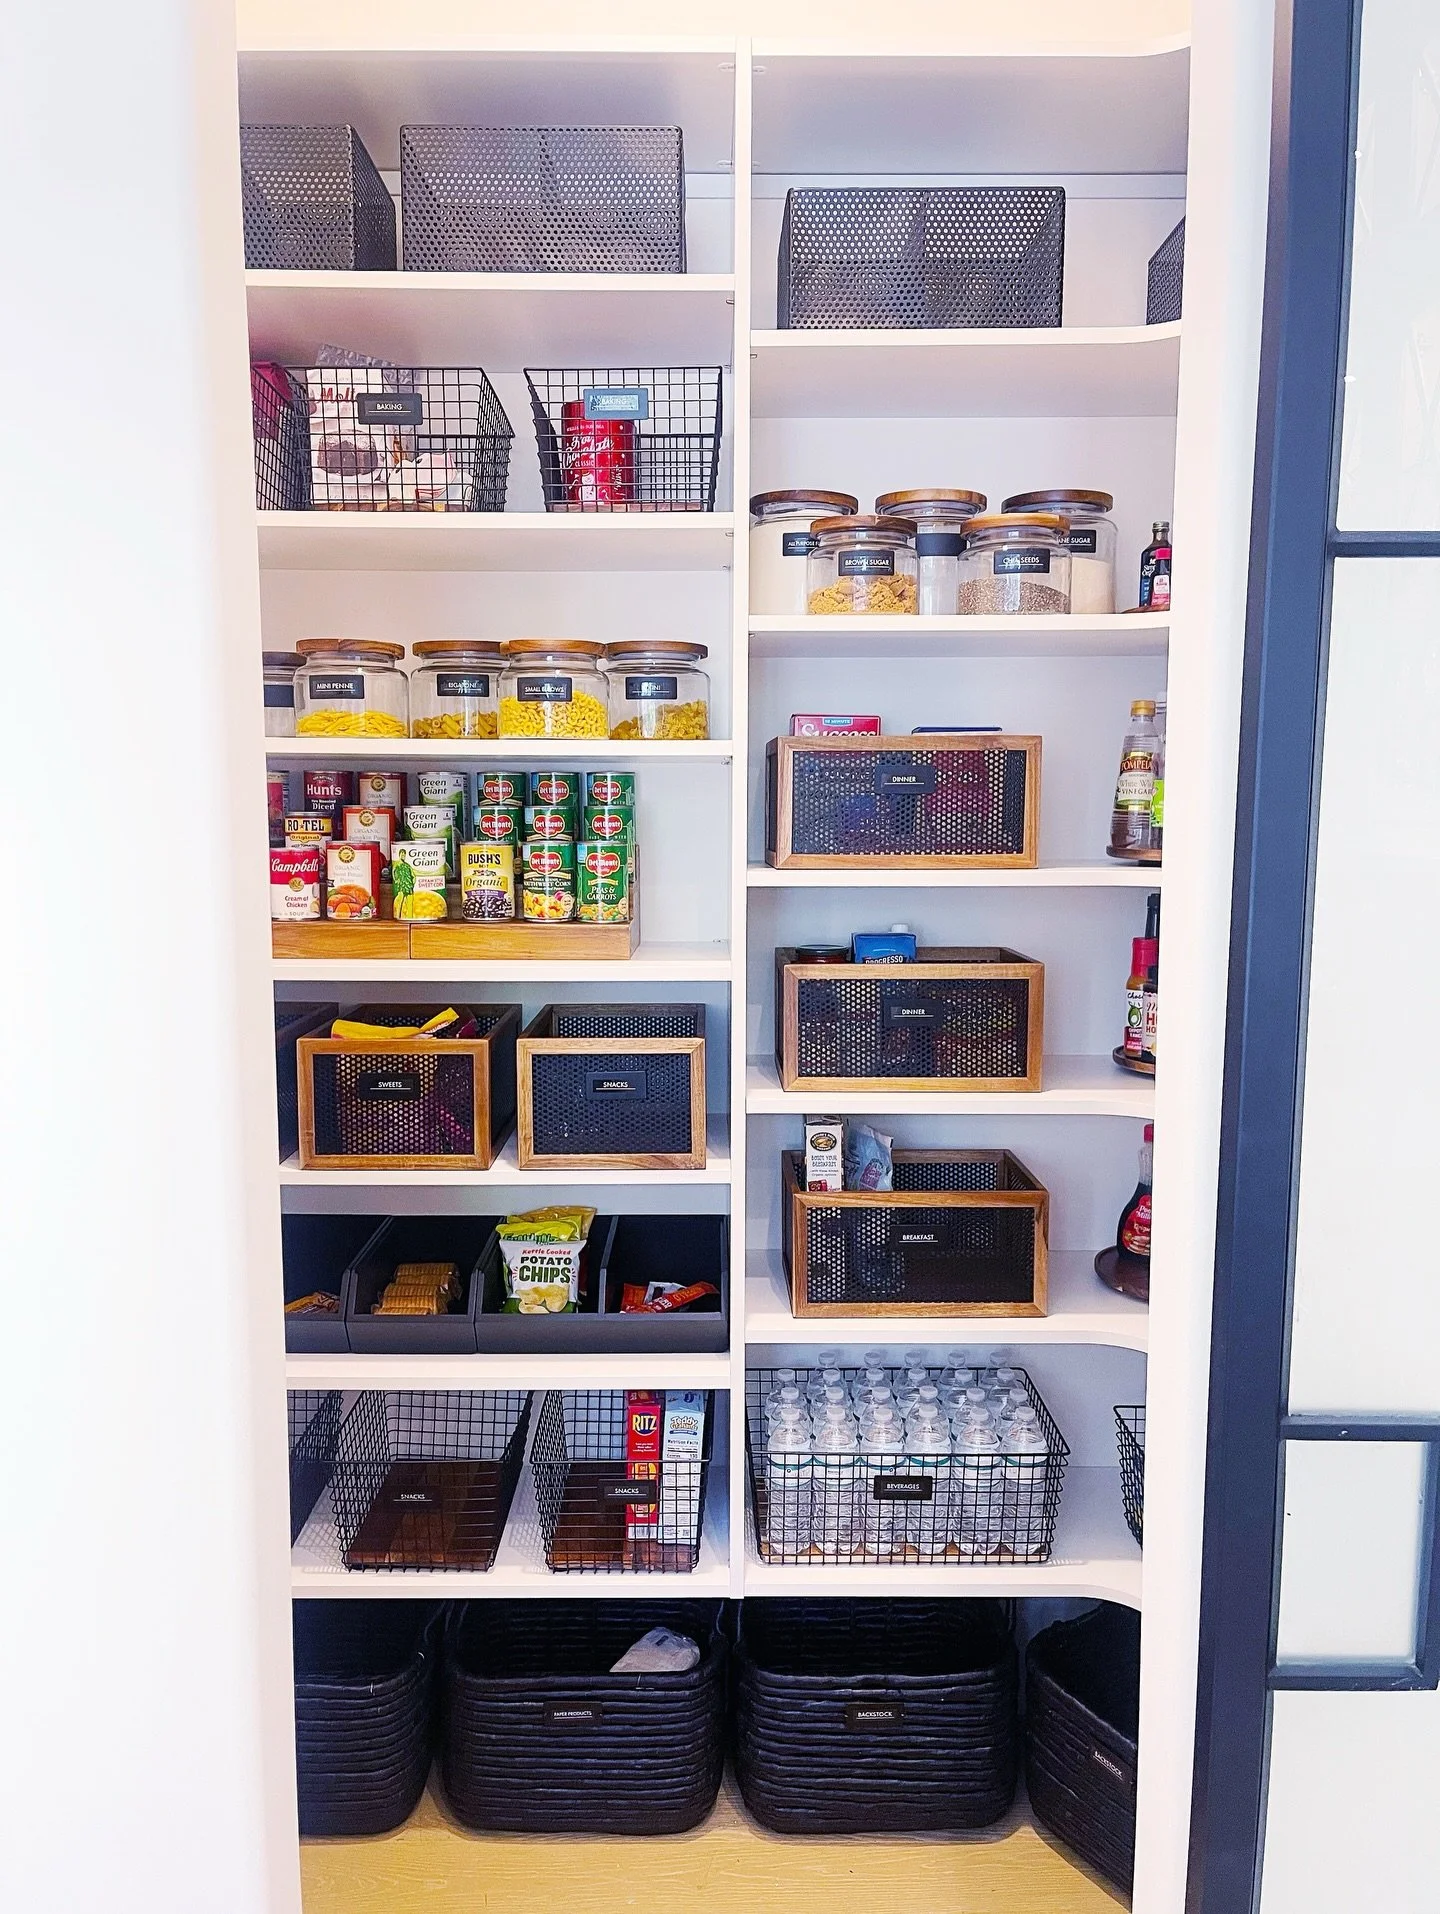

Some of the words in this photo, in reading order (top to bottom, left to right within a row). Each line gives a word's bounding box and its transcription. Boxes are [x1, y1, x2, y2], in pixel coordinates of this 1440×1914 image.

[601, 397, 627, 405] BAKING
[376, 403, 403, 411] BAKING
[1020, 556, 1040, 564] SEEDS
[316, 682, 332, 690] MINI
[331, 682, 354, 690] PENNE
[1121, 758, 1153, 772] POMPEIA
[421, 778, 447, 787] Green
[423, 787, 447, 796] Giant
[485, 785, 494, 793] Del
[539, 786, 549, 794] Del
[594, 786, 602, 794] Del
[312, 803, 336, 811] Diced
[408, 811, 437, 821] Green
[412, 820, 438, 830] Giant
[481, 820, 493, 829] Del
[534, 821, 545, 829] Del
[593, 820, 603, 829] Del
[408, 848, 438, 858] Green
[412, 857, 439, 867] Giant
[468, 853, 501, 865] BUSH'S
[588, 859, 598, 867] Del
[465, 877, 504, 888] Organic
[520, 1256, 572, 1266] POTATO
[518, 1265, 571, 1284] CHIPS
[632, 1414, 658, 1432] RITZ
[670, 1416, 699, 1427] Teddy
[886, 1482, 921, 1490] BEVERAGES
[1094, 1750, 1123, 1778] BACKSTOCK
